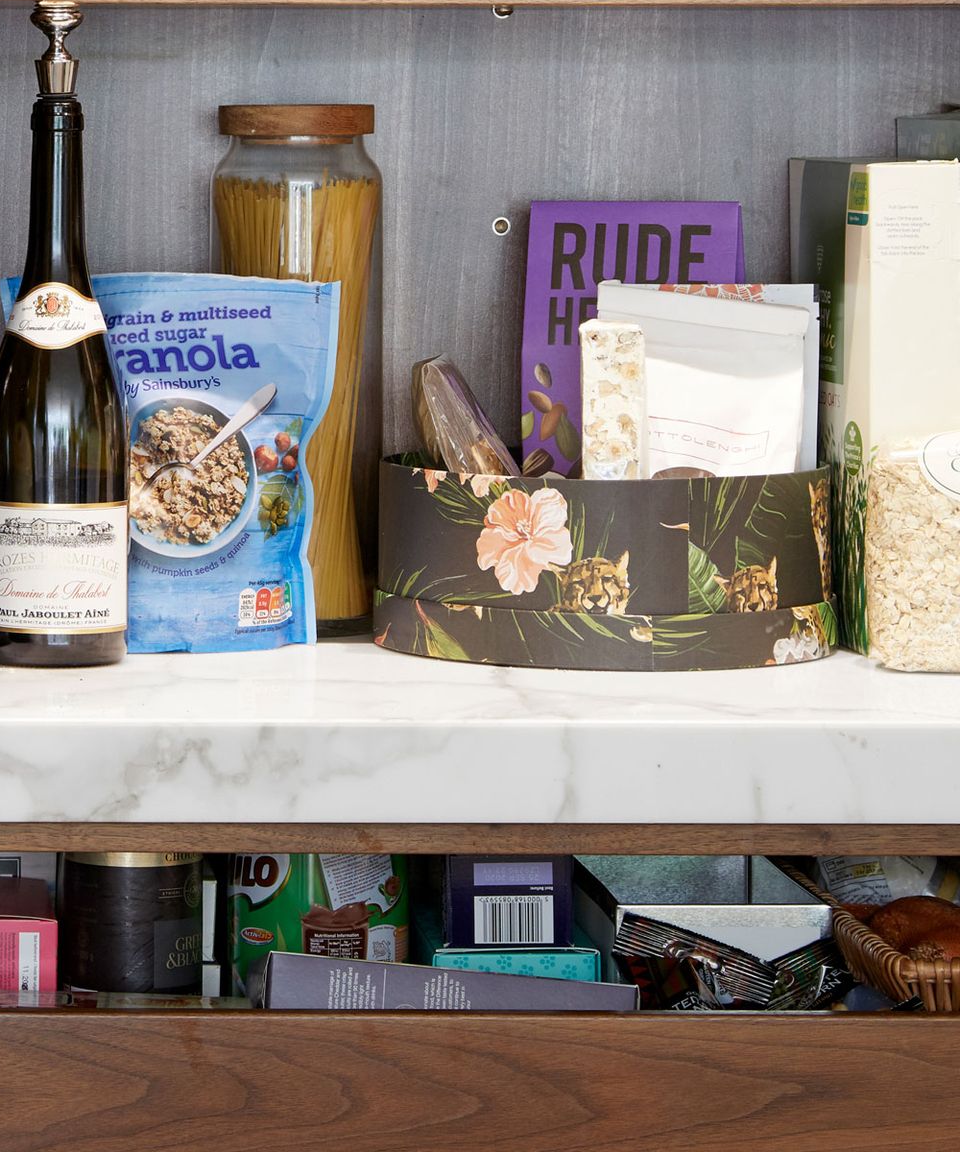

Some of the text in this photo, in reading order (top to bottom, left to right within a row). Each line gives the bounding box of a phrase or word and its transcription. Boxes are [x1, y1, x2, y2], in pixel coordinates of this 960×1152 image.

[550, 222, 712, 290] RUDE
[161, 309, 174, 323] &
[178, 305, 272, 323] multiseed
[155, 326, 208, 345] sugar
[124, 376, 221, 398] by Sainsbury's
[152, 564, 193, 578] pumpkin
[194, 561, 219, 576] seeds
[219, 556, 227, 565] &
[226, 532, 251, 560] quinoa
[46, 585, 59, 599] de
[62, 580, 112, 599] Thalabert
[21, 609, 82, 619] JABOULET
